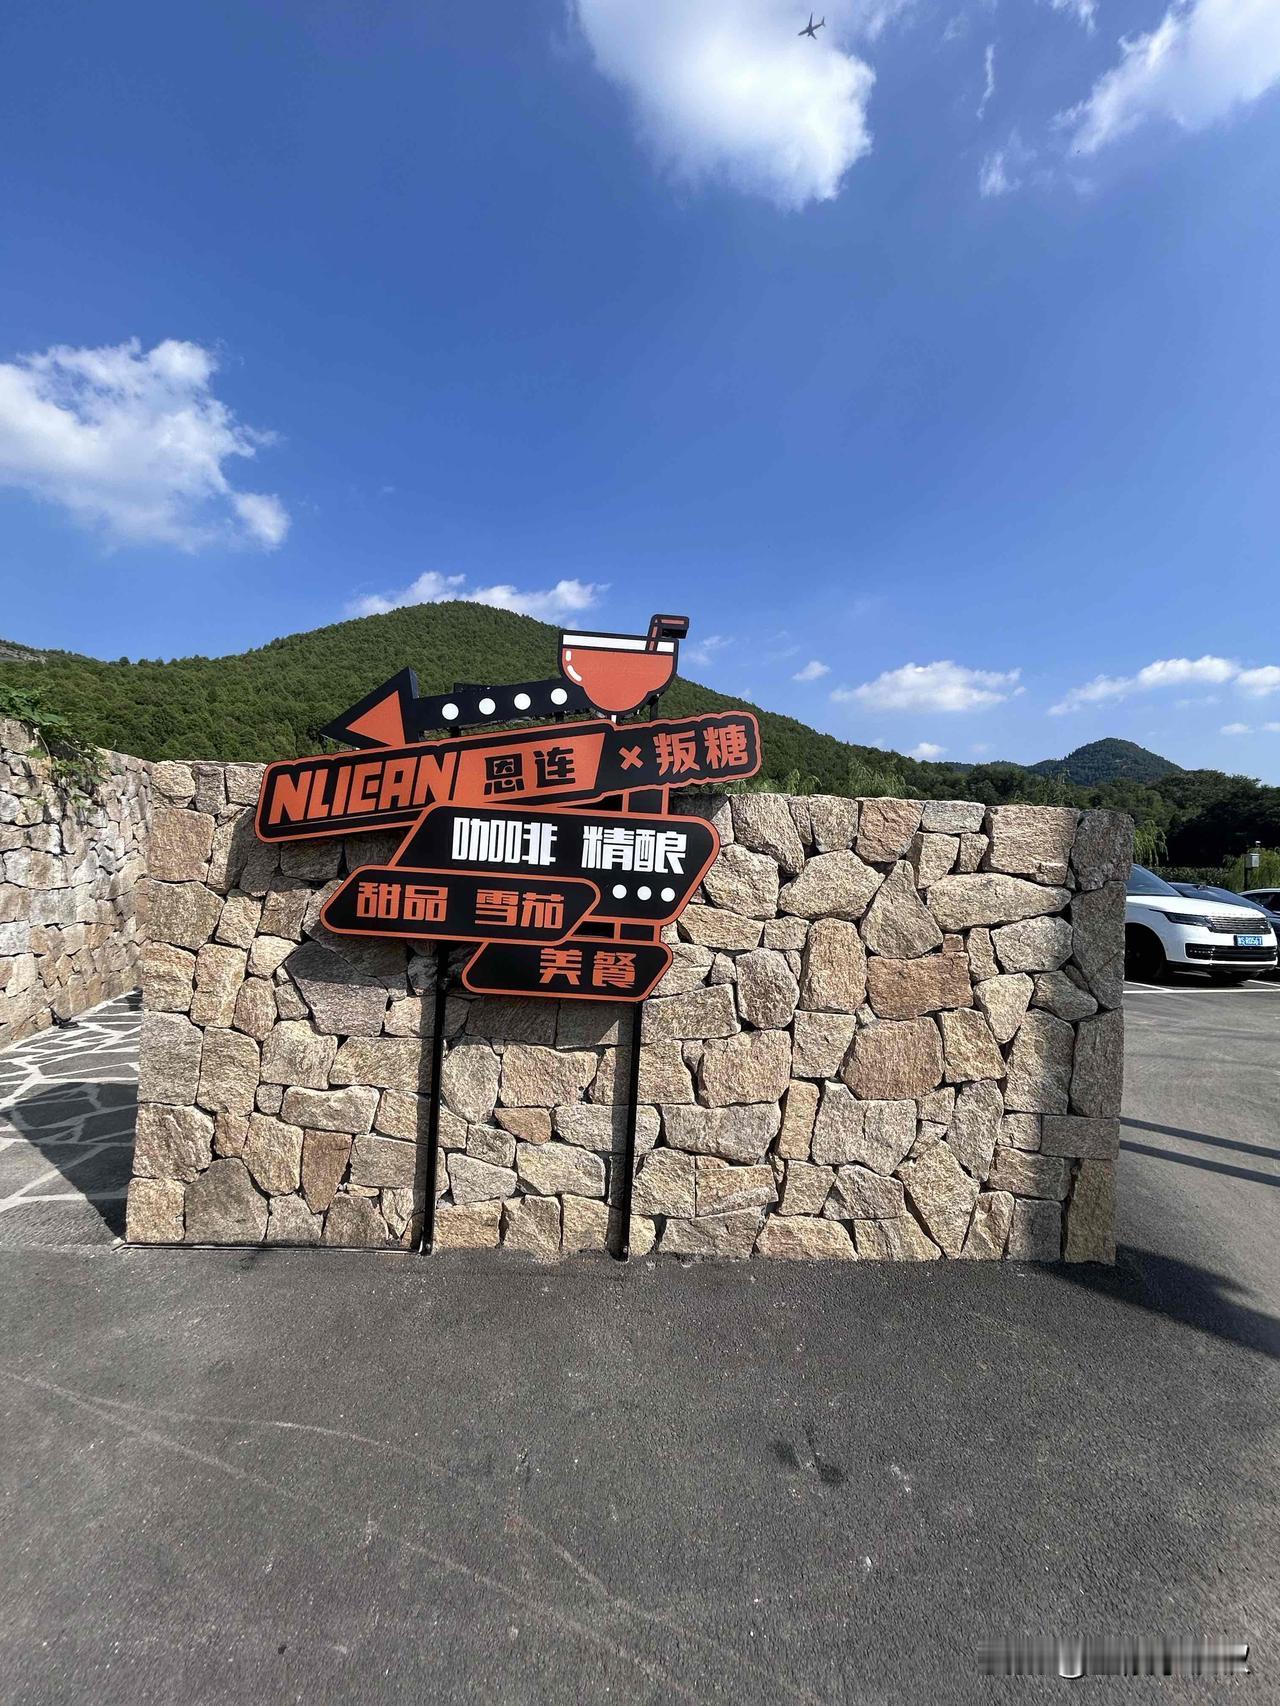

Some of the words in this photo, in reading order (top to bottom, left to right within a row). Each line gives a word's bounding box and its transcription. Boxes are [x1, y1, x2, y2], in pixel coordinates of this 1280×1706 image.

[484, 746, 576, 795] 恩连
[652, 724, 748, 776] 叛糖
[451, 817, 558, 866] 咖啡
[581, 825, 687, 875] 精酿
[356, 881, 449, 922] 甜品
[475, 888, 565, 929] 雪茄
[539, 948, 637, 989] 美餐
